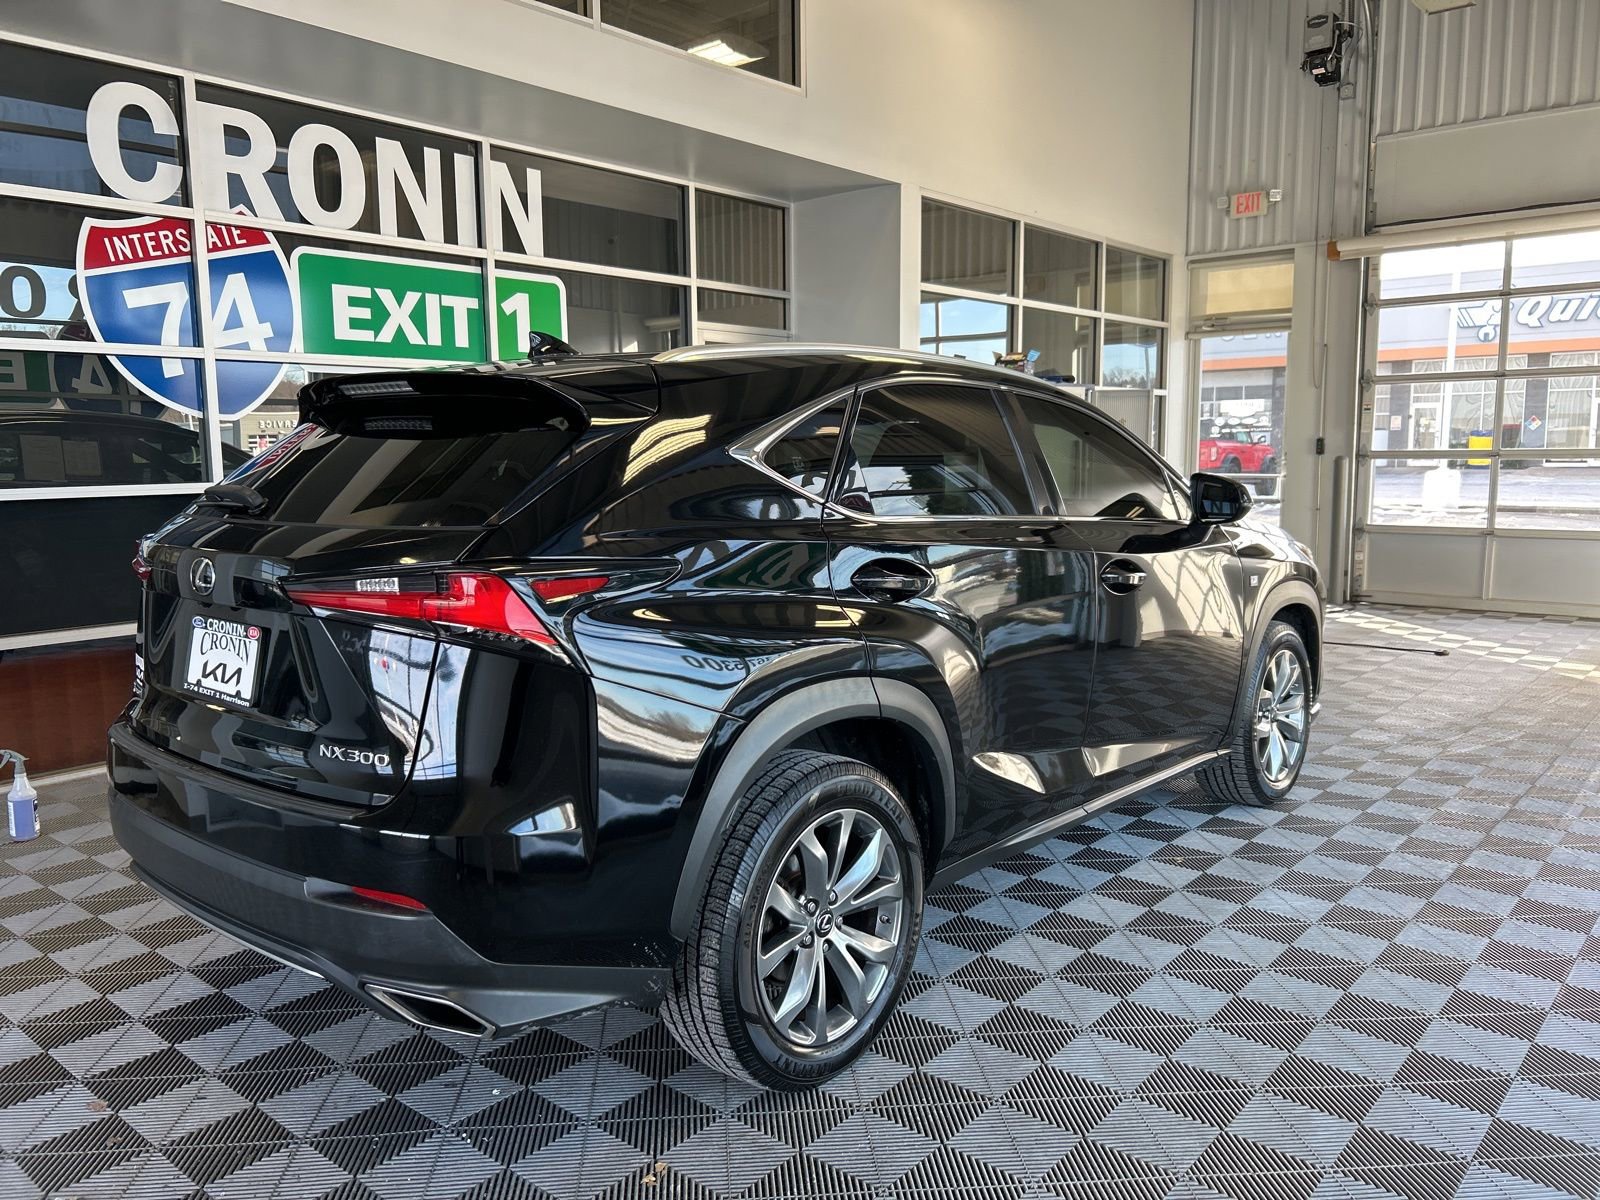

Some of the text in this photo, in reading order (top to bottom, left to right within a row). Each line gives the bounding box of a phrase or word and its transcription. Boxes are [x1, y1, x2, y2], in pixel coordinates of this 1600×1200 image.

[85, 82, 544, 257] CRONIN
[1236, 192, 1262, 215] EXIT
[104, 225, 247, 262] INTERSATE
[122, 272, 274, 379] 74
[332, 284, 531, 353] EXIT 1
[1516, 292, 1600, 328] Qui
[207, 618, 245, 637] CRONIN
[200, 631, 251, 666] CRONIN
[199, 687, 215, 697] EXIT
[221, 693, 250, 708] Harrison
[319, 744, 389, 767] NX300
